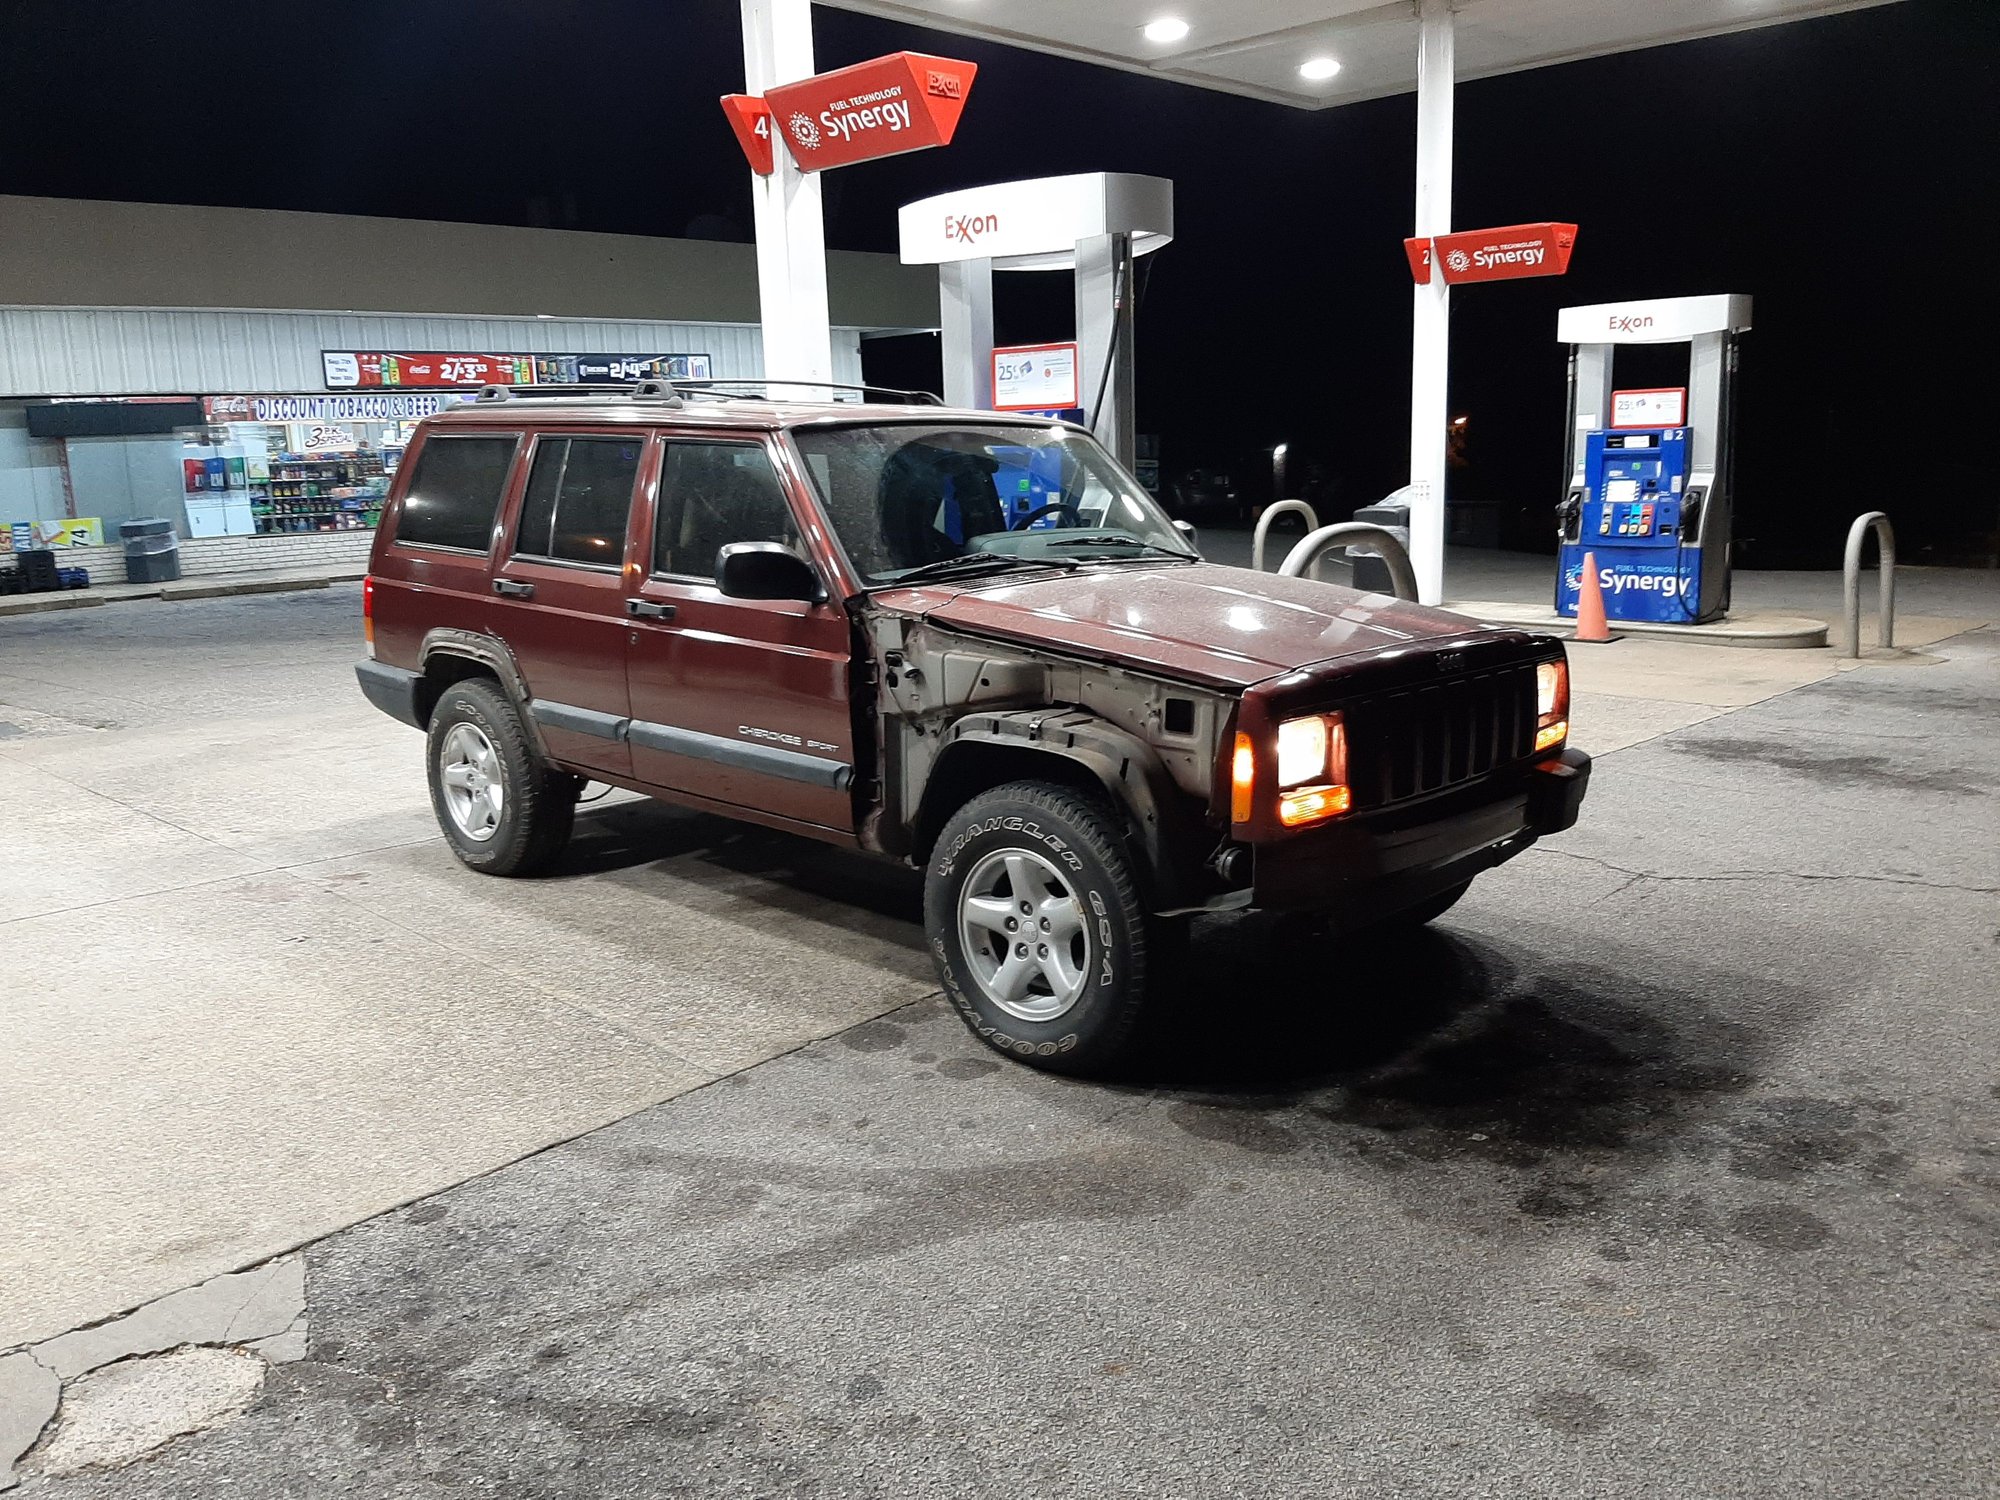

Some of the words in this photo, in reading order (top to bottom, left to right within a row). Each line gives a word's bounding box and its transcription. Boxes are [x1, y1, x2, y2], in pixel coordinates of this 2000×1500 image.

[829, 99, 850, 112] FUEL
[849, 85, 902, 108] TECHNOLOGY
[754, 116, 769, 139] 4
[820, 99, 911, 141] Synergy
[945, 213, 998, 244] Exxon
[1423, 250, 1430, 265] 2
[1473, 247, 1545, 269] Synergy
[1609, 316, 1653, 333] Exxon
[257, 397, 325, 420] DISCOUNT
[330, 397, 388, 418] TOBACCO
[391, 397, 403, 416] &
[406, 396, 439, 416] BEER
[305, 427, 323, 448] 3
[1674, 430, 1684, 440] 2
[1599, 568, 1692, 598] Synergy
[738, 725, 802, 746] CHEROKEE
[806, 740, 840, 752] SPORT
[938, 816, 1083, 877] WRANGLER
